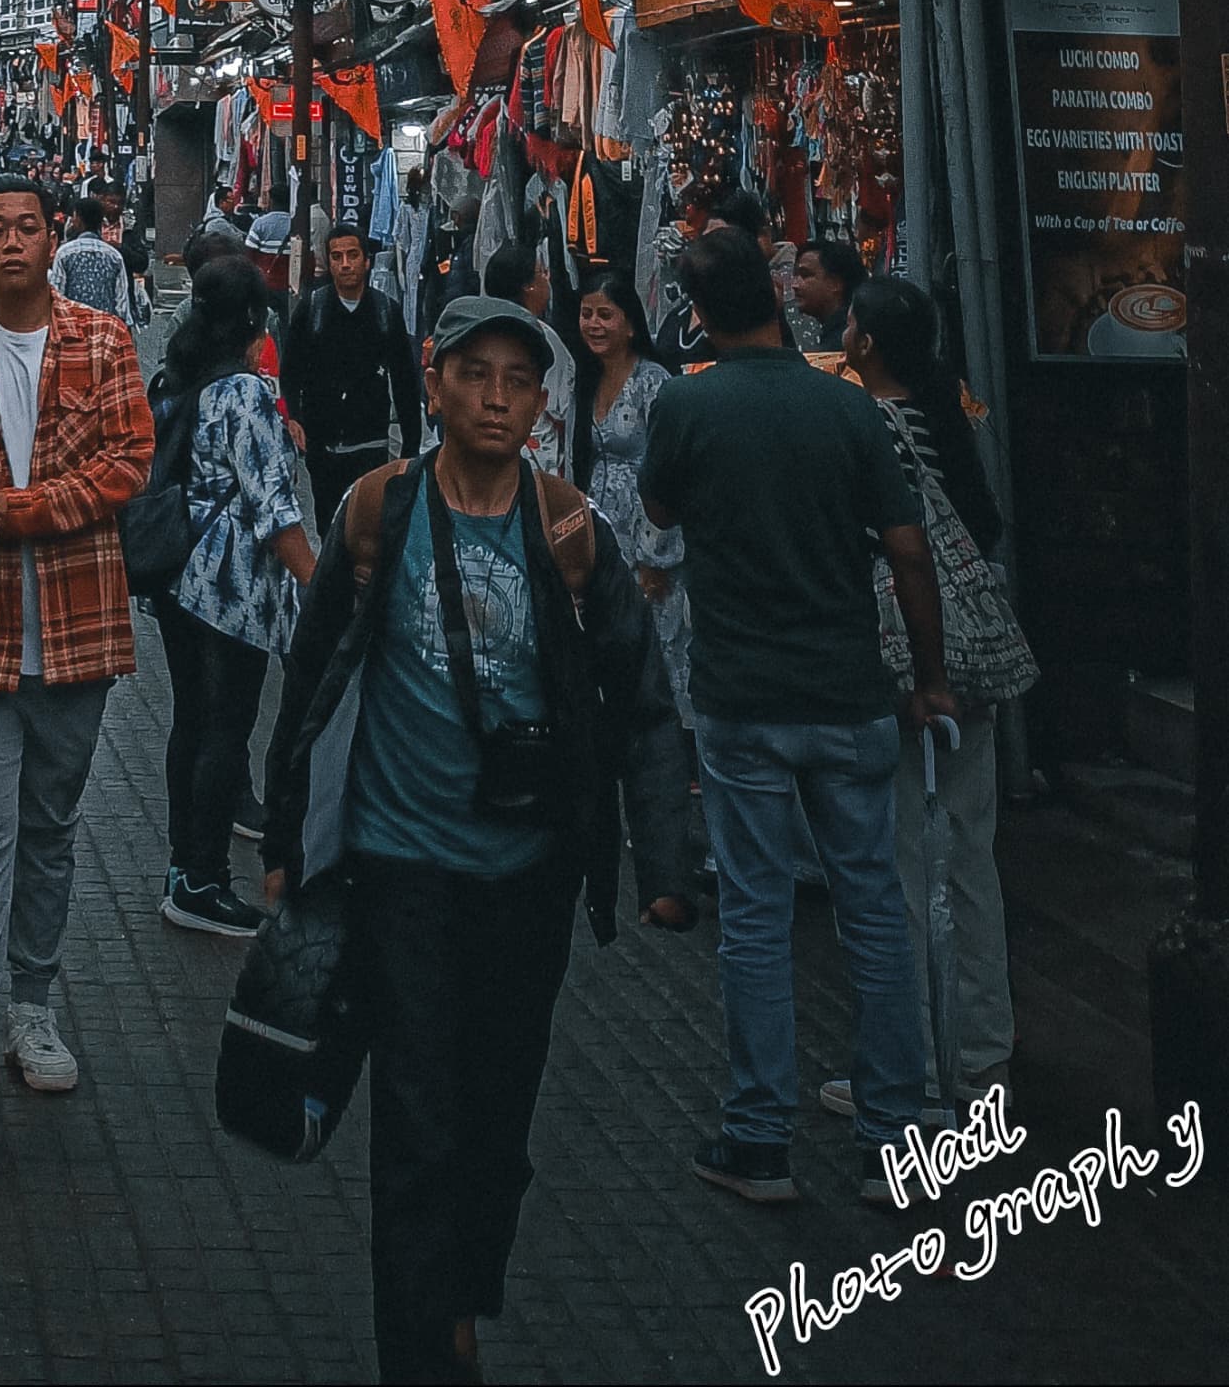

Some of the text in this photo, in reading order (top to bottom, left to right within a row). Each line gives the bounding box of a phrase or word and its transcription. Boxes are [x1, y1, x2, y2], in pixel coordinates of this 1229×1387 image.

[1059, 49, 1140, 71] LUCHI COMBO
[1052, 89, 1154, 111] PARATHA COMBO
[1026, 128, 1051, 148] EGG
[1053, 130, 1112, 151] VARIETIES
[1114, 131, 1145, 152] WITH
[1057, 170, 1161, 193] ENGLISH PLATTER
[1035, 215, 1062, 229] With
[1064, 220, 1070, 228] a
[1073, 215, 1096, 233] Cup
[1098, 216, 1111, 233] of
[1112, 217, 1134, 231] Tea
[1136, 220, 1149, 232] or
